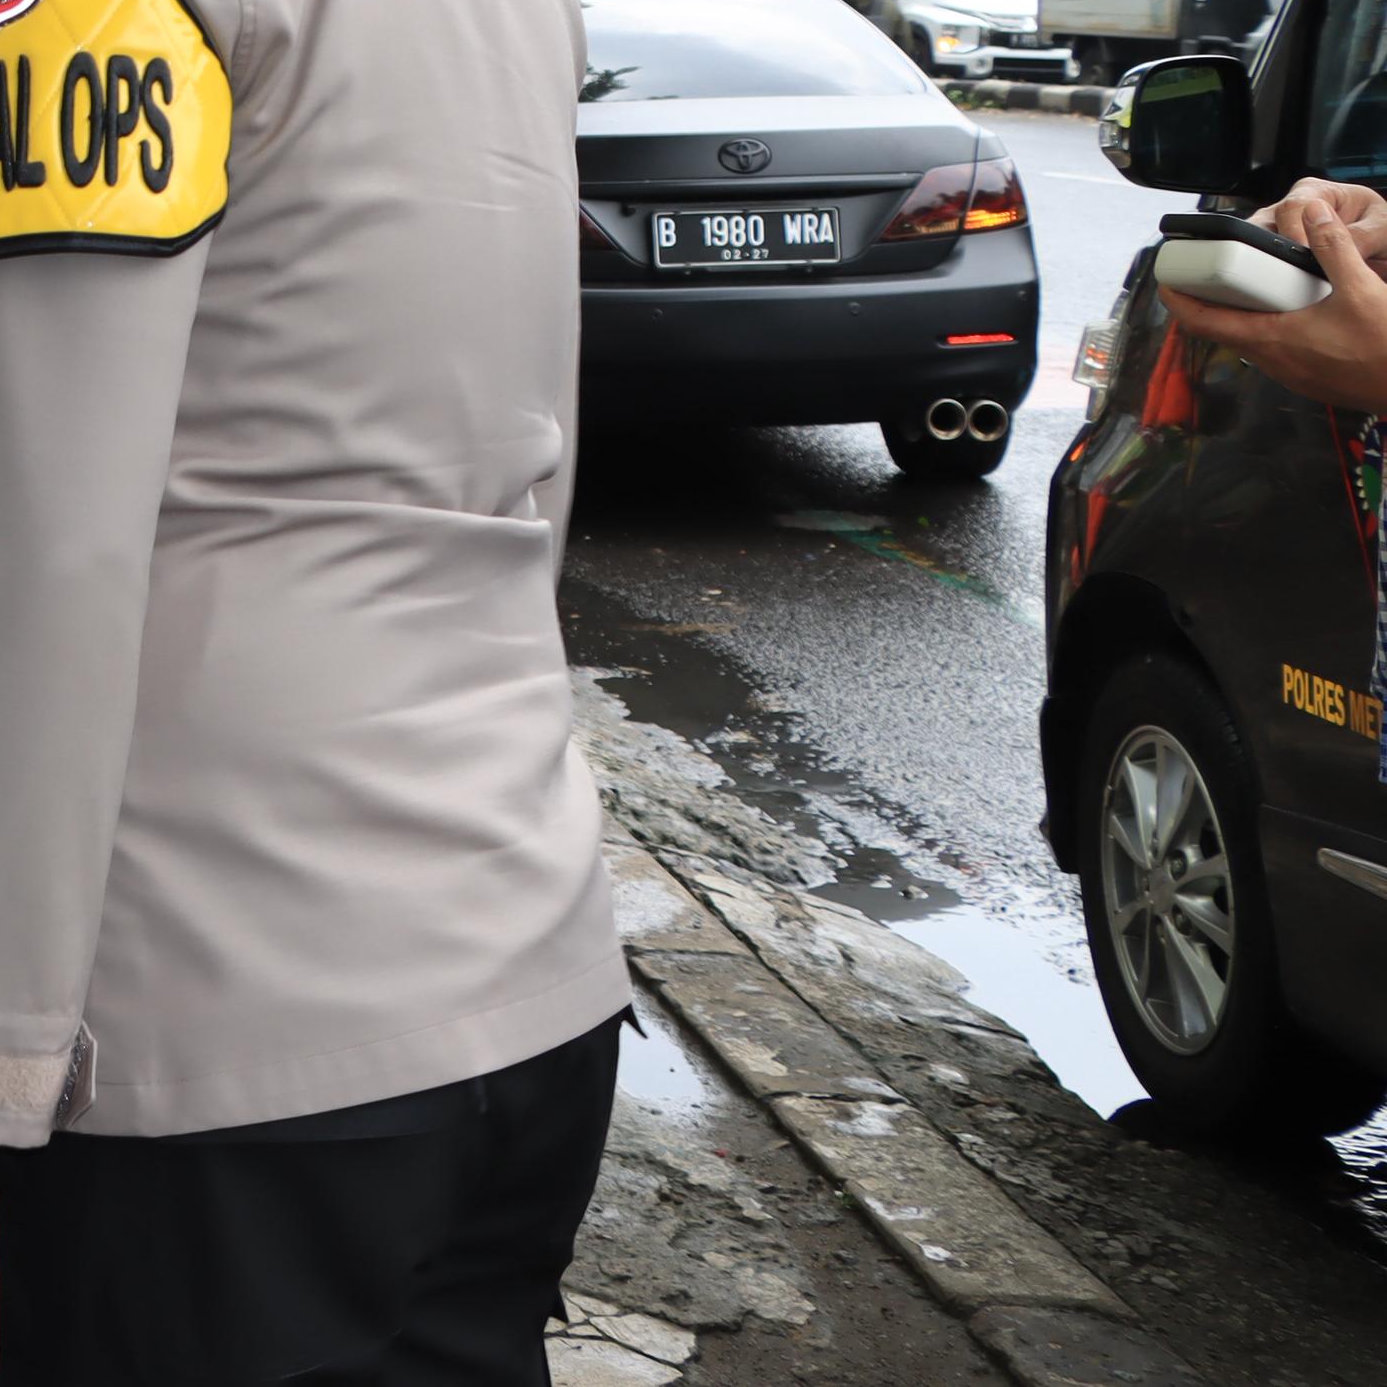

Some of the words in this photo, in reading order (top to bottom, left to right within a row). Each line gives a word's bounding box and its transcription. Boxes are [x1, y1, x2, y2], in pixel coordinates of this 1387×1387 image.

[61, 52, 173, 193] OPS
[658, 217, 677, 248] B
[701, 215, 765, 247] 1980
[783, 212, 834, 245] WRA
[1282, 663, 1345, 726] POLRES
